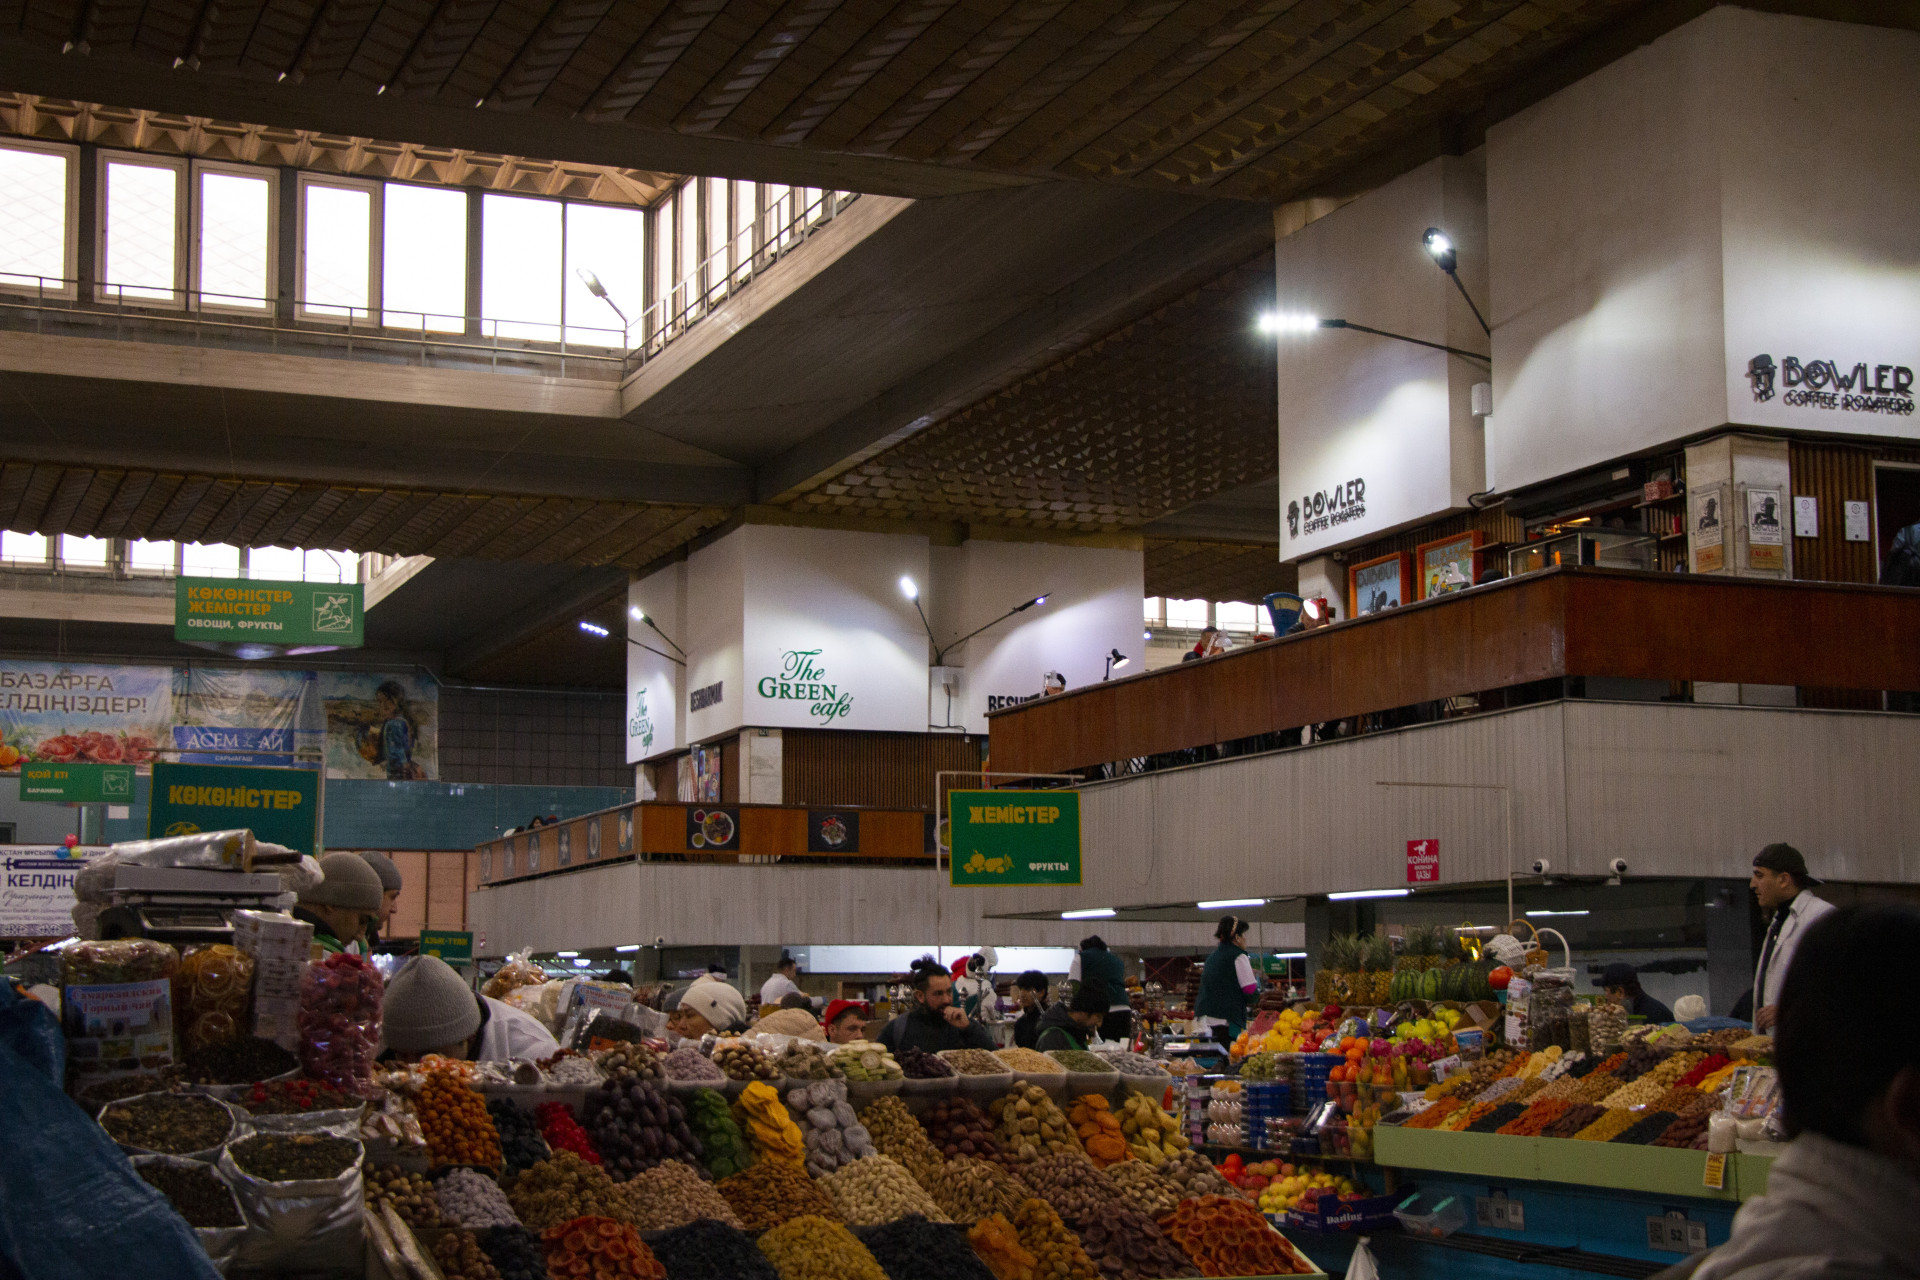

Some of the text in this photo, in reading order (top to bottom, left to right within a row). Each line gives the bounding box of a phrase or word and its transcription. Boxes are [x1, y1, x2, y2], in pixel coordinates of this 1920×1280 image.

[1783, 356, 1914, 397] BOWLER
[1785, 389, 1915, 415] COFFEE ROASTERS
[1303, 477, 1366, 520] BOWLER
[1303, 503, 1366, 534] COFFEE ROASTERS
[187, 587, 294, 605] КӨКӨНІСТЕР,
[188, 600, 271, 615] ЖЕМІСТЕР
[187, 618, 283, 631] ОВОЩИ, ФРУКТЫ
[780, 648, 825, 681] The
[1, 671, 114, 692] БАЗАРҒА
[758, 677, 838, 701] GREEN
[0, 692, 147, 715] ЛДІҢІЗДЕР!
[810, 692, 854, 726] café
[629, 716, 651, 738] GREEN
[1028, 861, 1070, 872] ФРУКТЫ
